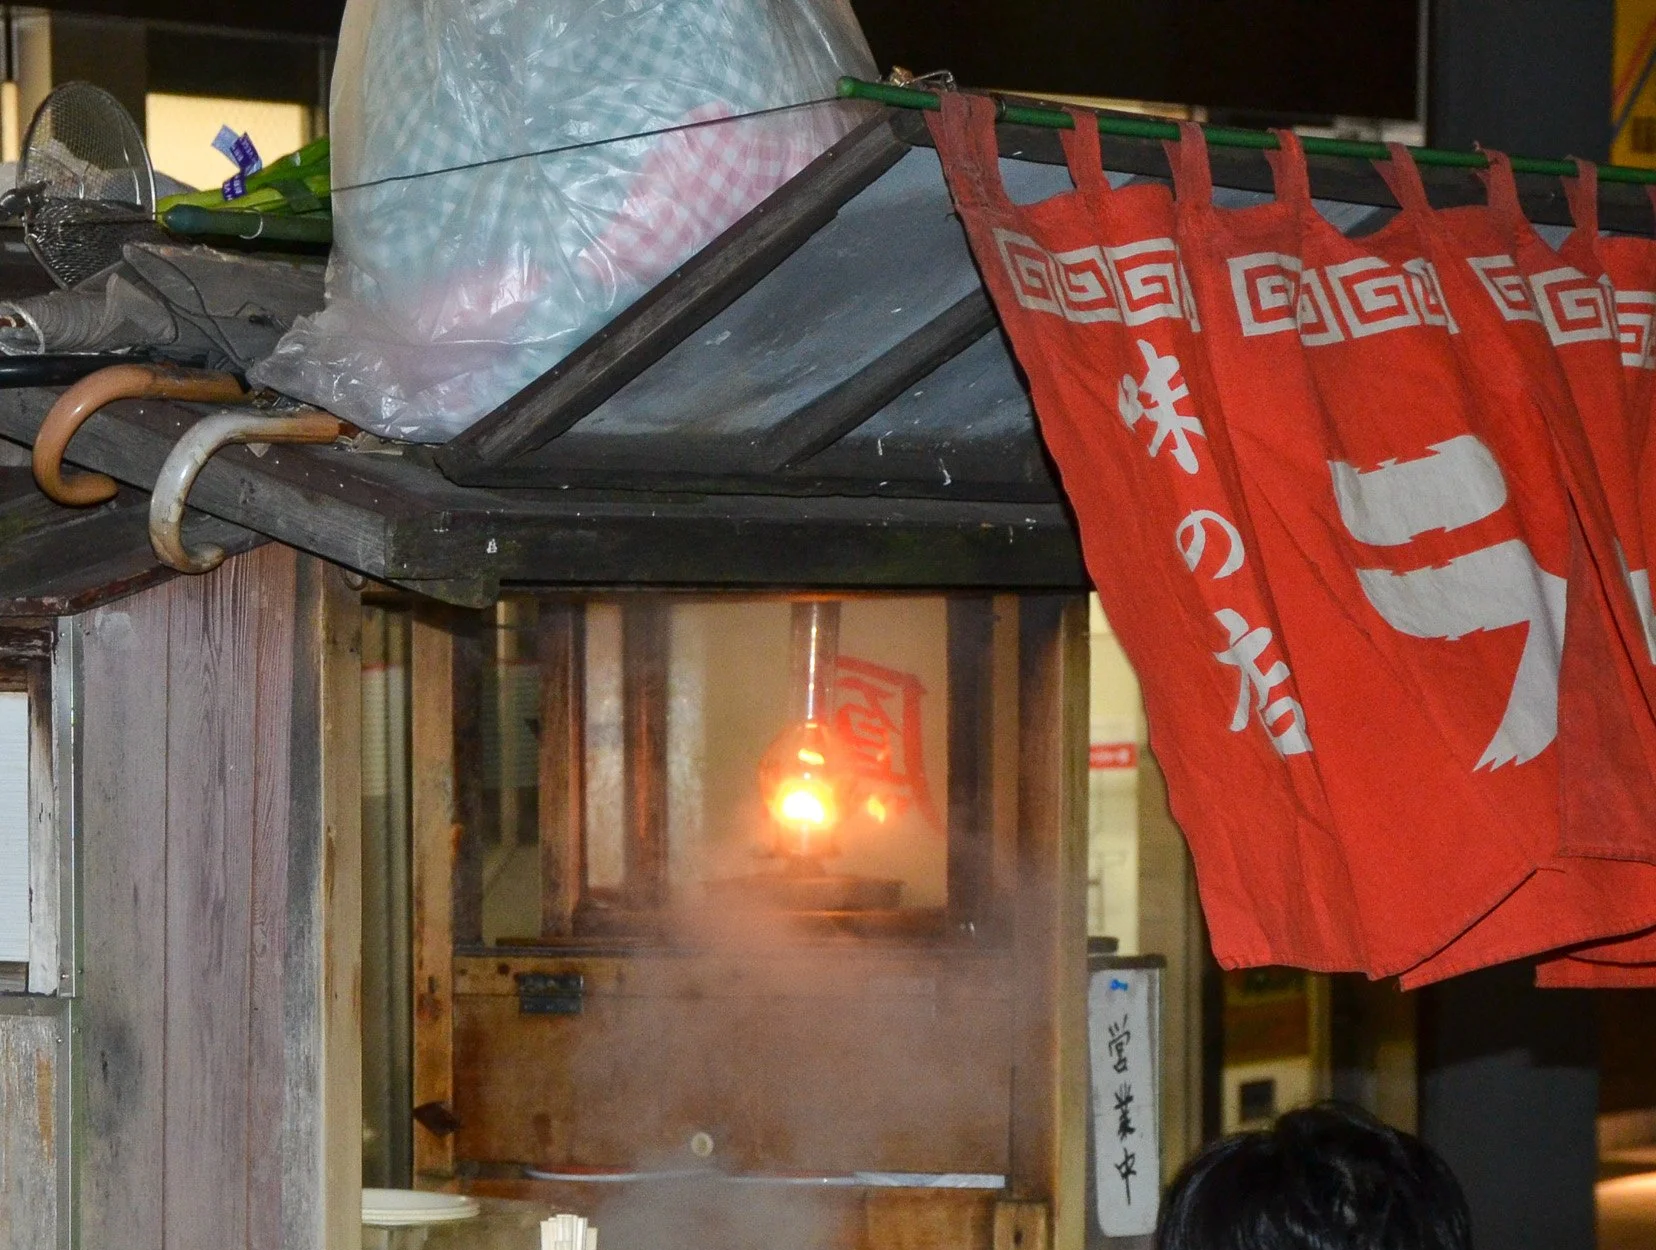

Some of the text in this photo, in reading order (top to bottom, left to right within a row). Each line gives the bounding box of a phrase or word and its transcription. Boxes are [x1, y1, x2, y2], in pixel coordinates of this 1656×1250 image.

[1116, 339, 1313, 756] 味の店
[1106, 1013, 1138, 1206] 営業中
